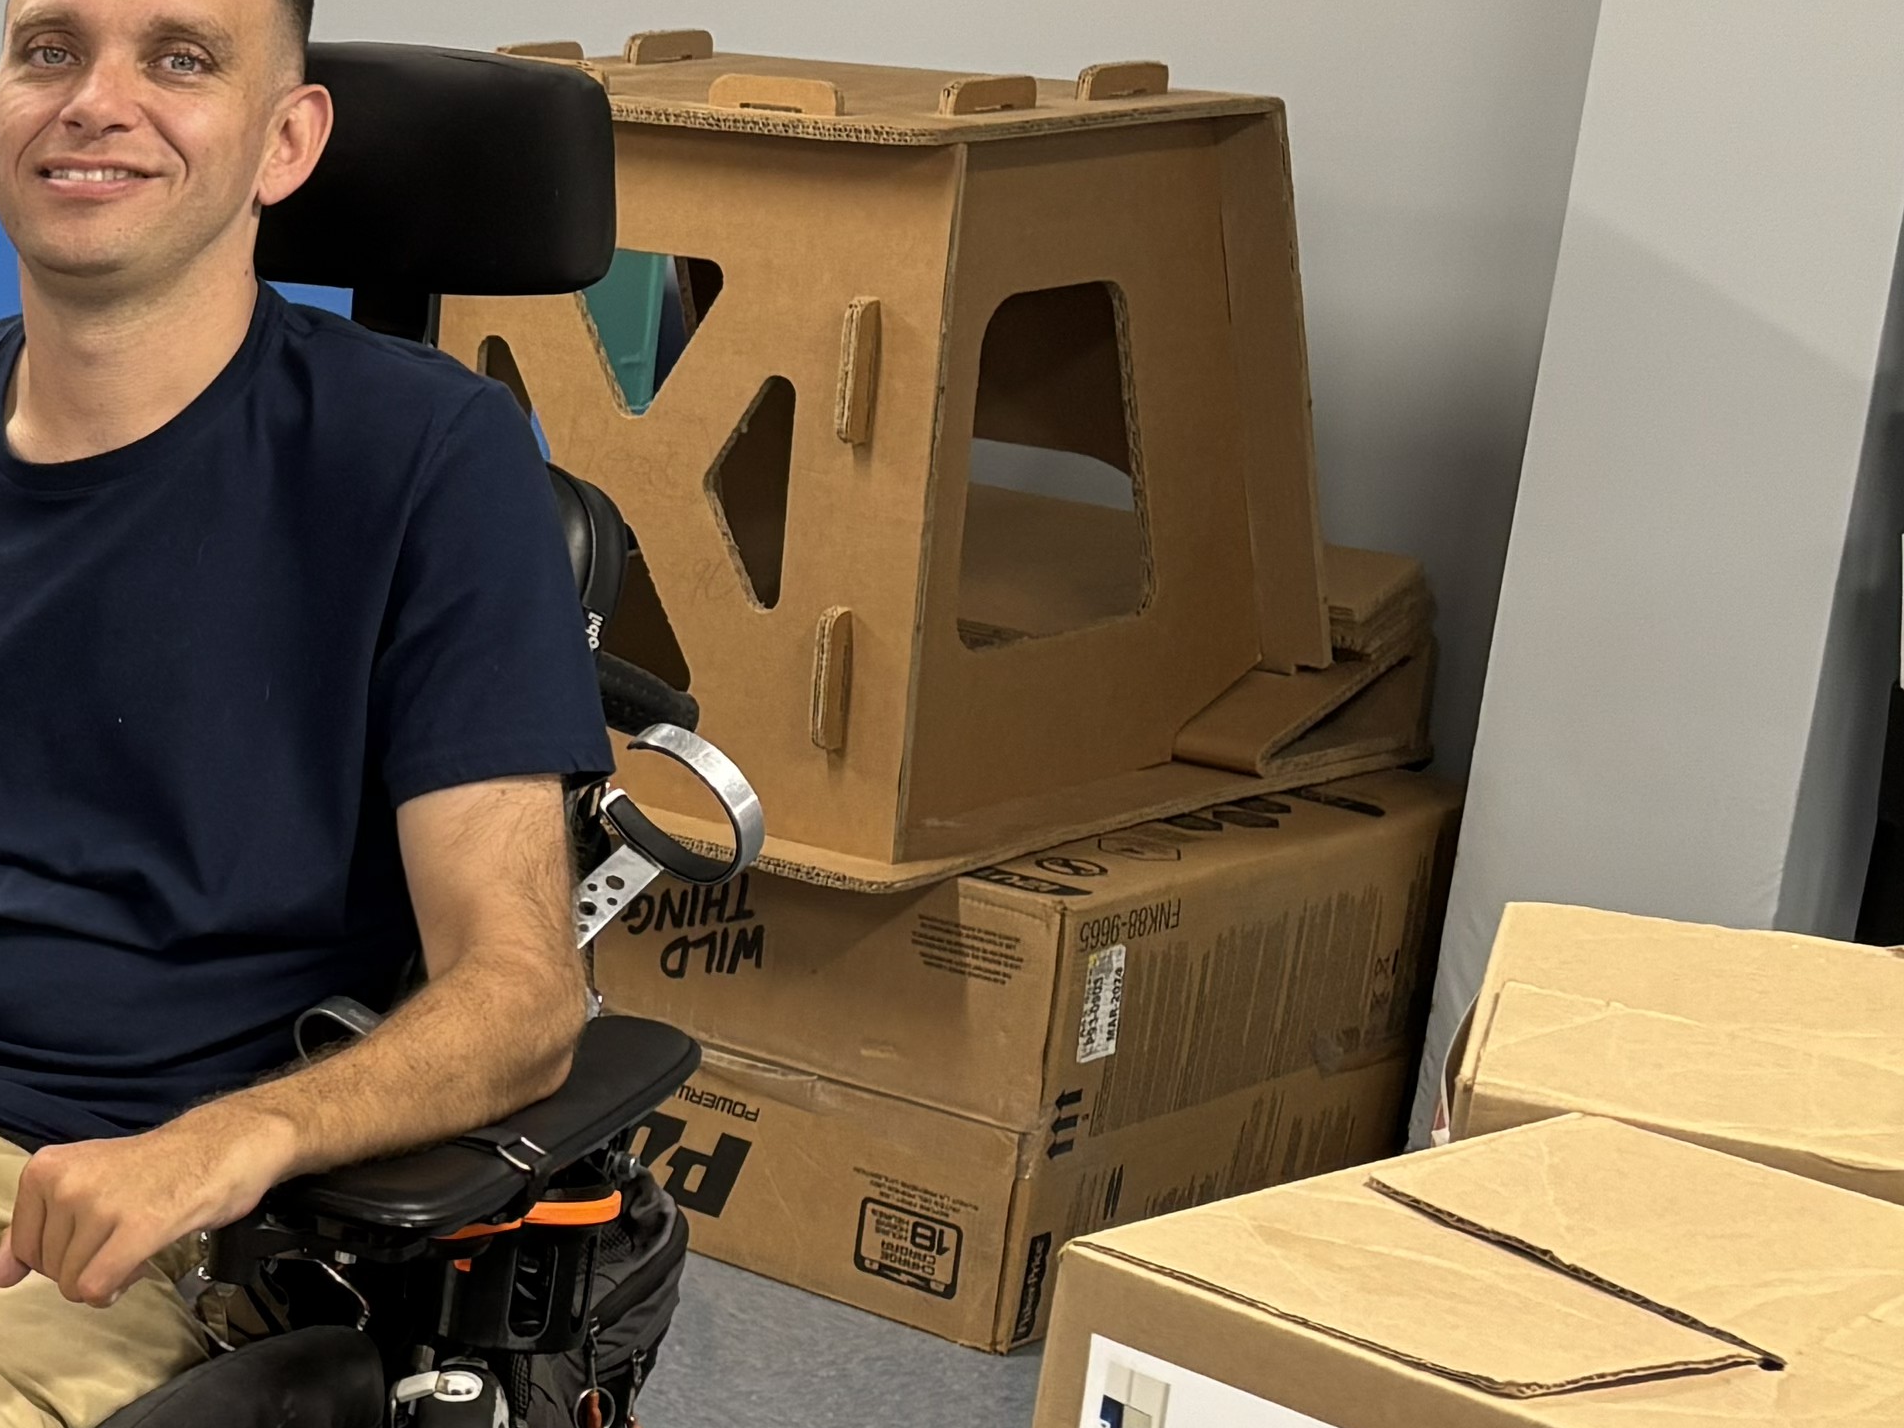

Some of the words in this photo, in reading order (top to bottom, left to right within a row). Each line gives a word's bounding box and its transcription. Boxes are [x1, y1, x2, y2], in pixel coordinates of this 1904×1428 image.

[621, 872, 754, 935] THING
[1080, 898, 1181, 952] FNK88-9665
[660, 925, 765, 979] WILD
[910, 1221, 950, 1256] 18
